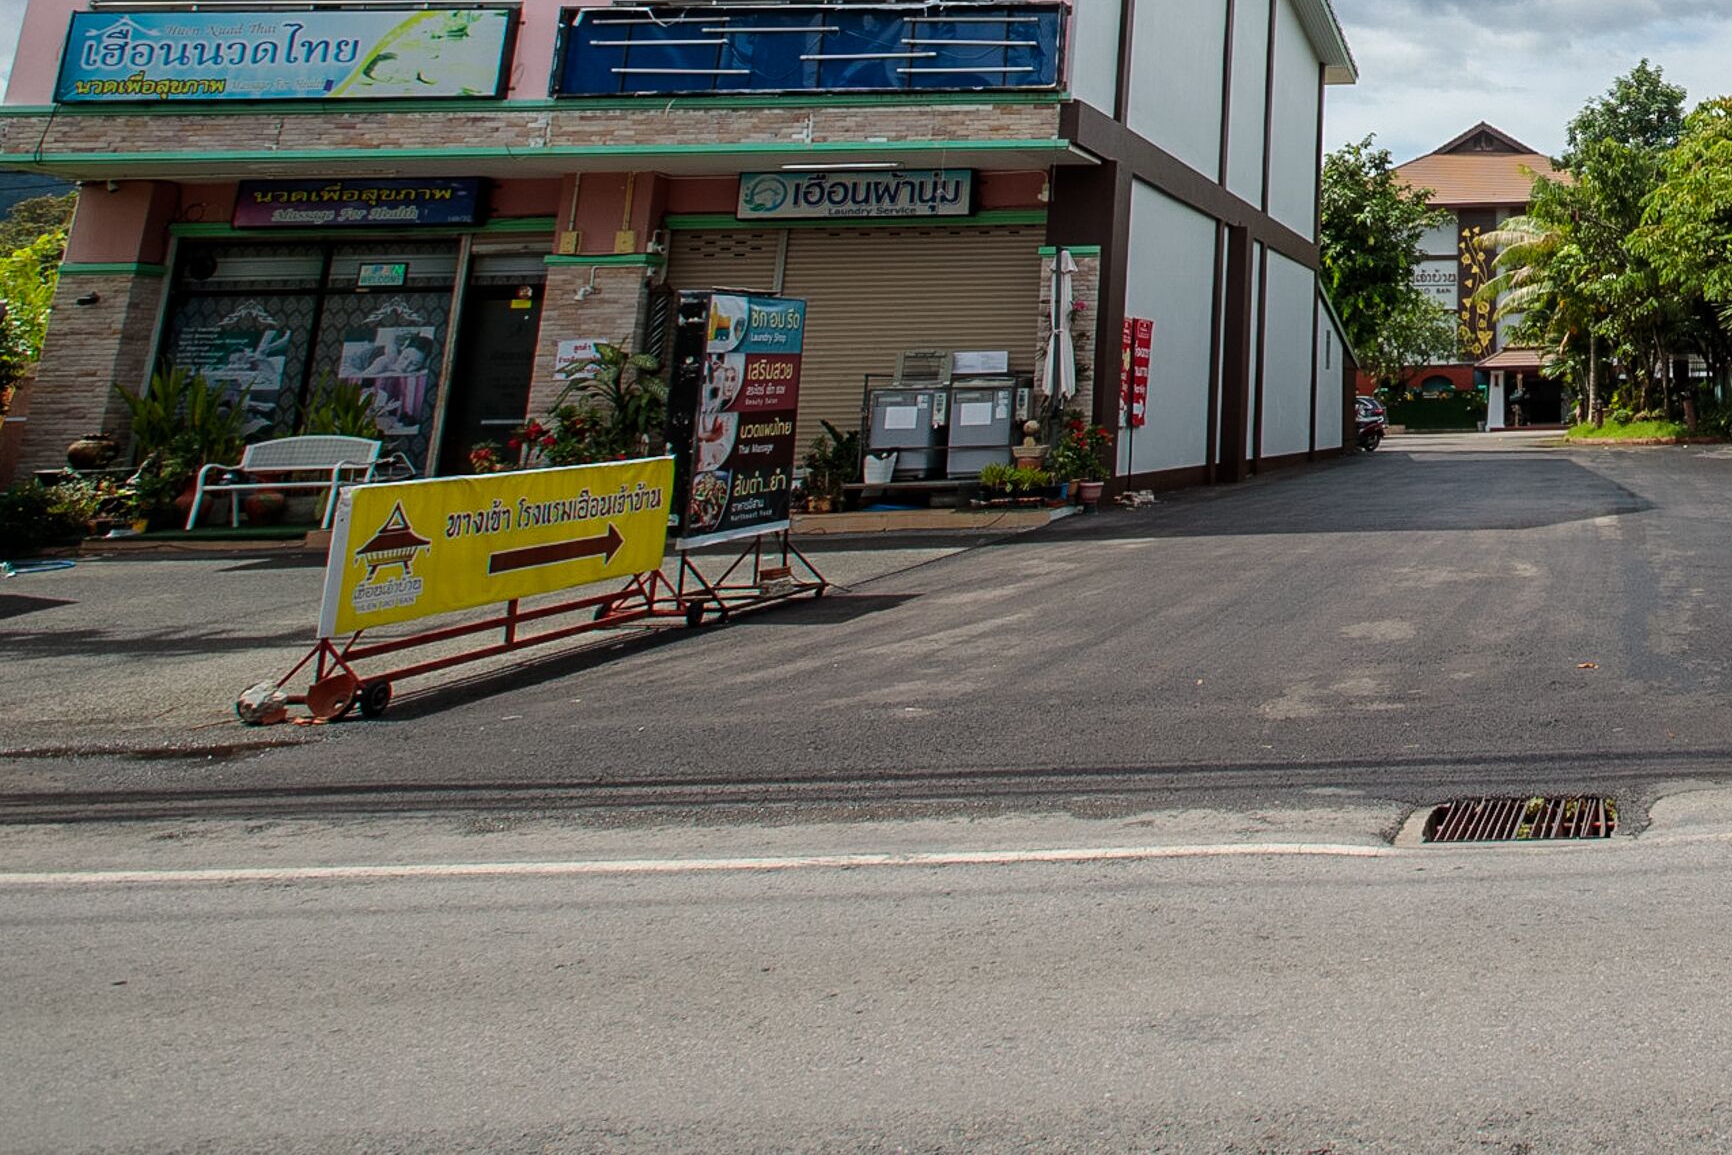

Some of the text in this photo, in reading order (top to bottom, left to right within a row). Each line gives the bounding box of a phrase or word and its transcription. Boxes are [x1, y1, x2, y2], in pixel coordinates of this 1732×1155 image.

[83, 22, 360, 67] เฮือนนวดไทย
[75, 71, 226, 99] นวดเพื่อสุขภาพ
[254, 182, 451, 206] นวดเพื่อสุขภาพ
[792, 171, 962, 213] เฮือนผ้านุ่ม
[272, 206, 418, 224] Massage For Health
[828, 206, 917, 216] Laundry Service
[446, 500, 511, 538] ทางเข้า
